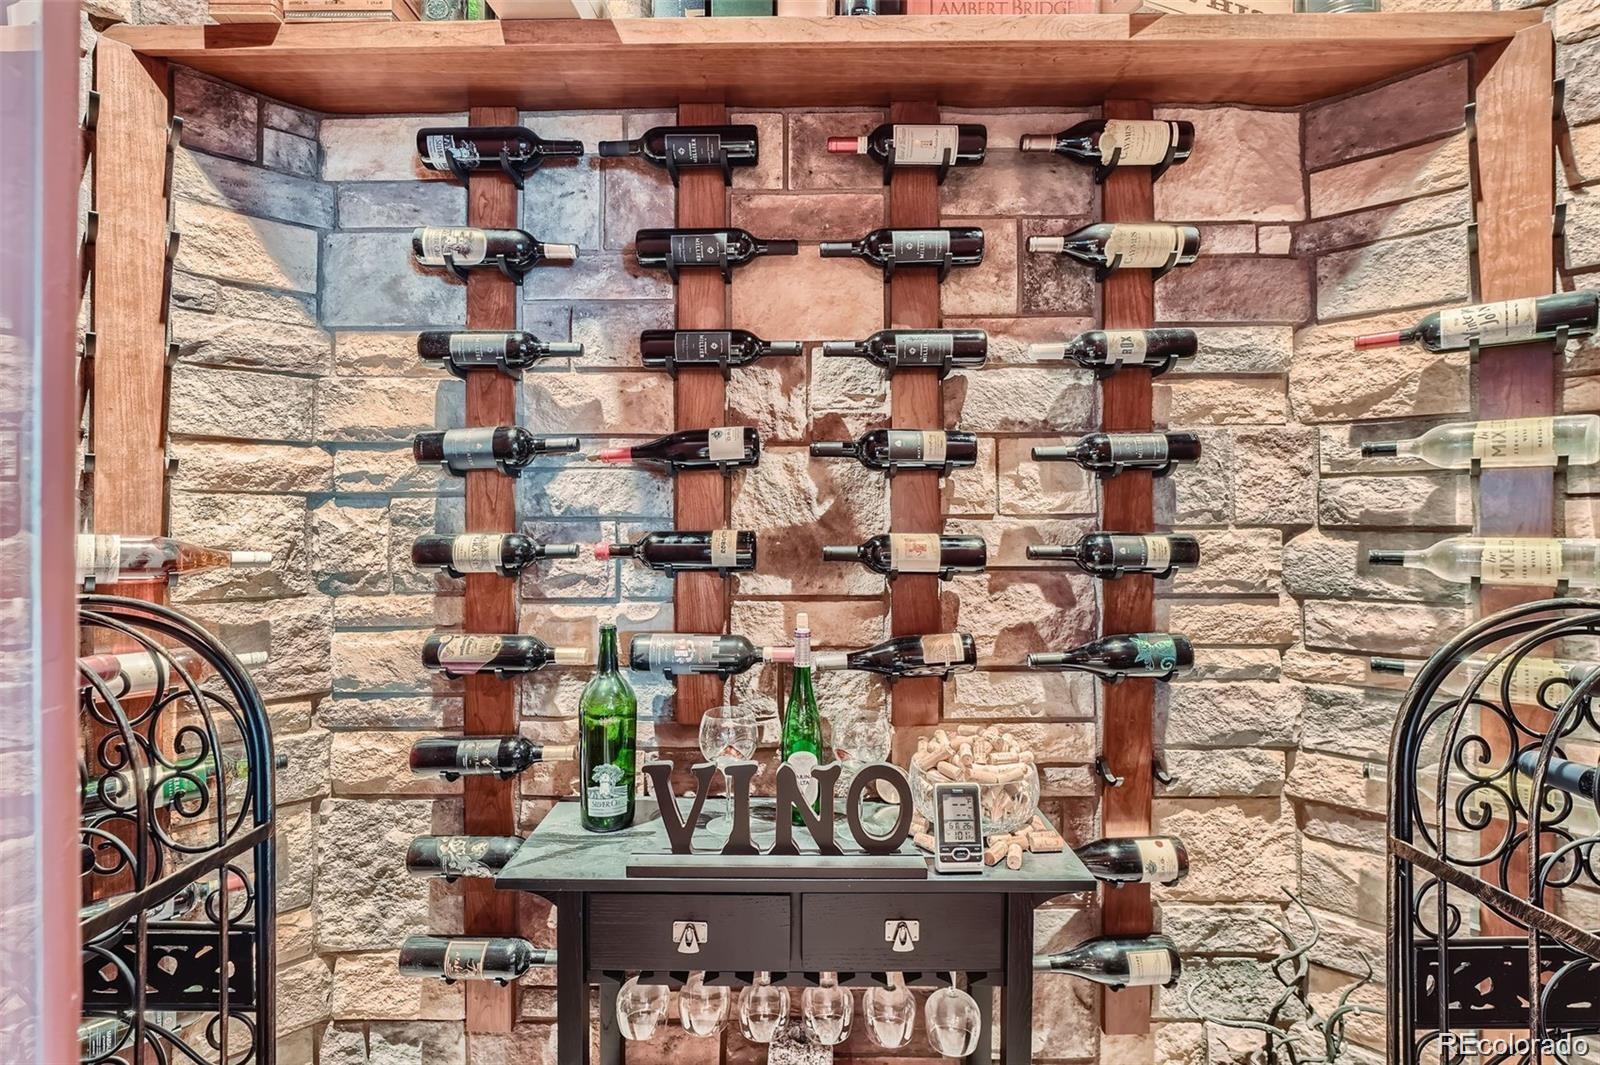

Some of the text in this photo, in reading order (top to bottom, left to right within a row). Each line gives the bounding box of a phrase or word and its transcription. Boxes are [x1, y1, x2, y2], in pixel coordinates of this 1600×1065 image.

[929, 0, 1075, 15] LAMBERT BRIDGE
[1499, 539, 1516, 580] MIXED
[642, 760, 913, 855] VINO
